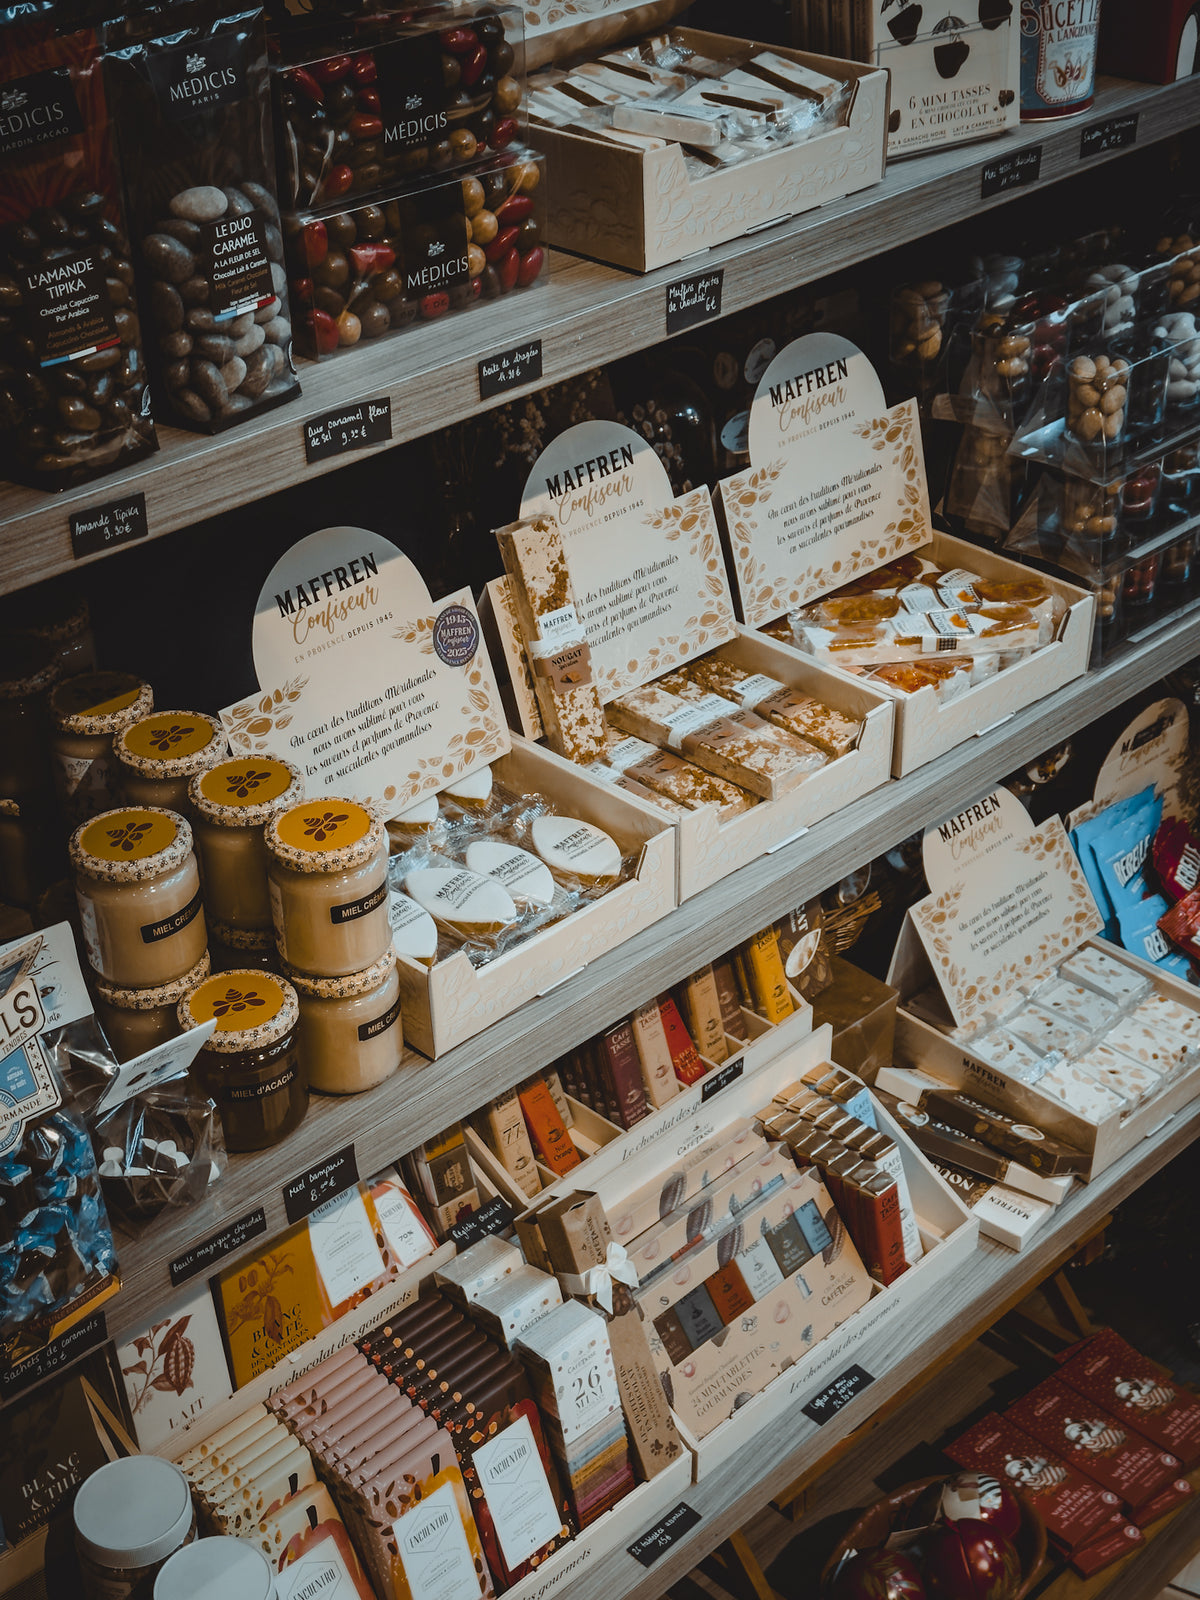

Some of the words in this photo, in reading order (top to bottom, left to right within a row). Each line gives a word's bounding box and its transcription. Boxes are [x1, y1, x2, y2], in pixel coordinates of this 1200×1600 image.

[169, 67, 236, 102] MÉDICIS
[909, 96, 916, 111] 6
[921, 92, 947, 108] MINI
[952, 83, 991, 103] TASSES
[191, 93, 220, 107] PARIS
[384, 111, 448, 144] MÉDICIS
[911, 118, 925, 130] EN
[929, 103, 989, 125] CHOCOLAT
[405, 135, 428, 146] PARIS
[215, 224, 228, 239] LE
[229, 216, 252, 235] DUO
[213, 231, 258, 256] CARAMEL
[213, 269, 236, 281] Chocolat
[237, 263, 245, 274] Lait
[250, 256, 268, 269] Caramel
[214, 261, 220, 270] A
[220, 258, 229, 268] LA
[228, 252, 245, 265] FLEUR
[245, 249, 252, 259] DE
[252, 247, 261, 257] SEL
[27, 258, 94, 291] L'AMANDE
[406, 254, 470, 290] MÉDICIS
[427, 279, 450, 291] PARIS
[46, 278, 87, 300] TIPIKA
[668, 301, 677, 313] de
[680, 291, 706, 310] chocolat
[669, 283, 695, 301] Muffins
[40, 302, 69, 317] Chocolat
[56, 314, 67, 323] Pur
[68, 306, 90, 320] Arabica
[501, 357, 510, 369] de
[768, 357, 849, 408] MAFFREN
[328, 408, 363, 429] caramel
[368, 405, 389, 424] fleur
[777, 385, 848, 432] Confiseur
[819, 416, 840, 431] DEPUIS
[842, 410, 856, 422] 1945
[310, 437, 320, 447] de
[545, 443, 635, 500] MAFFREN
[558, 473, 634, 527] Confiseur
[604, 507, 627, 522] DEPUIS
[629, 500, 645, 512] 1945
[75, 513, 110, 537] Amande
[113, 506, 139, 523] Tipika
[275, 552, 379, 618] MAFFREN
[288, 584, 379, 645] Confiseur
[543, 612, 573, 629] MAFFREN
[294, 653, 305, 664] EN
[307, 636, 346, 658] PROVENCE
[347, 620, 374, 639] DEPUIS
[376, 612, 394, 625] 1945
[441, 626, 472, 638] MAFFREN
[446, 646, 468, 658] 2025
[551, 649, 582, 667] NOUGAT
[290, 734, 305, 749] Au
[307, 722, 329, 742] cœur
[331, 715, 344, 730] des
[346, 697, 383, 722] traditions
[384, 668, 437, 704] Méridionales
[765, 688, 793, 705] NOUGAT
[312, 741, 332, 756] nous
[333, 729, 357, 746] avons
[357, 708, 387, 735] sublimé
[388, 703, 407, 721] pour
[408, 693, 425, 708] vous
[667, 709, 696, 726] MAFFREN
[306, 764, 318, 777] les
[319, 747, 351, 770] saveurs
[351, 739, 360, 753] et
[361, 726, 393, 752] parfums
[393, 718, 404, 731] de
[404, 700, 441, 725] Provence
[324, 773, 335, 786] en
[336, 750, 380, 779] succulentes
[381, 721, 434, 758] gourmandises
[937, 793, 1001, 843] MAFFREN
[553, 826, 589, 851] MAFFREN
[950, 815, 1003, 861] Confiseur
[489, 853, 526, 877] MAFFREN
[1113, 833, 1150, 888] REBELLE
[435, 871, 470, 899] MAFFREN
[341, 902, 364, 919] MIEL
[153, 923, 174, 937] MIEL
[367, 1017, 385, 1035] MIEL
[231, 1088, 255, 1099] MIEL
[257, 1068, 294, 1096] d'ACACIA
[962, 1057, 1006, 1089] MAFFREN
[502, 1122, 521, 1145] 77
[622, 1148, 635, 1161] Le
[636, 1116, 675, 1151] chocolat
[675, 1107, 692, 1123] des
[289, 1182, 306, 1198] Miel
[989, 1195, 1031, 1220] MAFFREN
[234, 1213, 263, 1235] chocolat
[398, 1229, 414, 1243] 70%
[252, 1303, 301, 1343] BLANC
[3, 1354, 40, 1384] Sachets
[46, 1343, 58, 1358] de
[61, 1319, 98, 1348] caramels
[268, 1380, 284, 1400] Le
[283, 1342, 336, 1389] chocolat
[337, 1328, 357, 1351] des
[358, 1288, 412, 1340] gourmets
[803, 1344, 842, 1381] chocolat
[843, 1333, 859, 1350] des
[858, 1297, 901, 1341] gourmets
[251, 1346, 261, 1359] &
[572, 1365, 602, 1402] 26
[697, 1370, 753, 1417] GOURMANDES
[575, 1385, 603, 1410] MINI
[169, 1395, 205, 1430] LAIT
[22, 1450, 81, 1498] BLANC
[489, 1443, 528, 1480] ENCUENTRO
[31, 1497, 42, 1511] &
[409, 1511, 449, 1550] ENCUENTRO
[533, 1547, 594, 1597] gourmets
